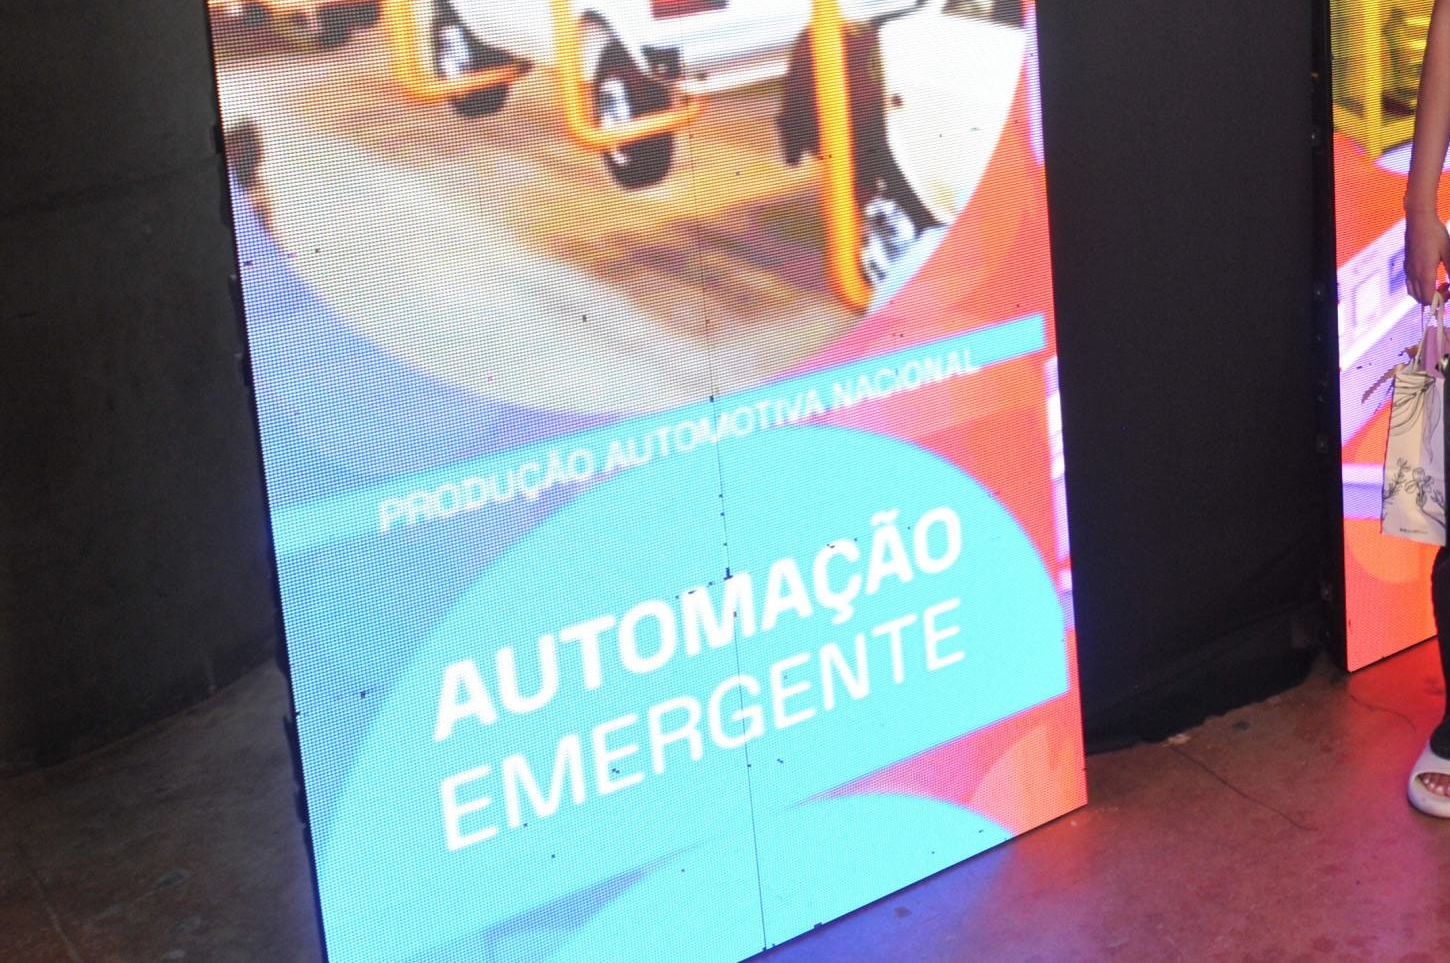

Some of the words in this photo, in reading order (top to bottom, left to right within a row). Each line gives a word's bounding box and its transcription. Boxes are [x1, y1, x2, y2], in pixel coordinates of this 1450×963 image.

[378, 445, 596, 534] PRODUÇÃO
[602, 388, 825, 472] AUTOMOTIVA
[832, 348, 981, 409] NACIONAL
[433, 506, 963, 740] AUTOMAÇÃO
[438, 596, 967, 853] EMERGENTE
